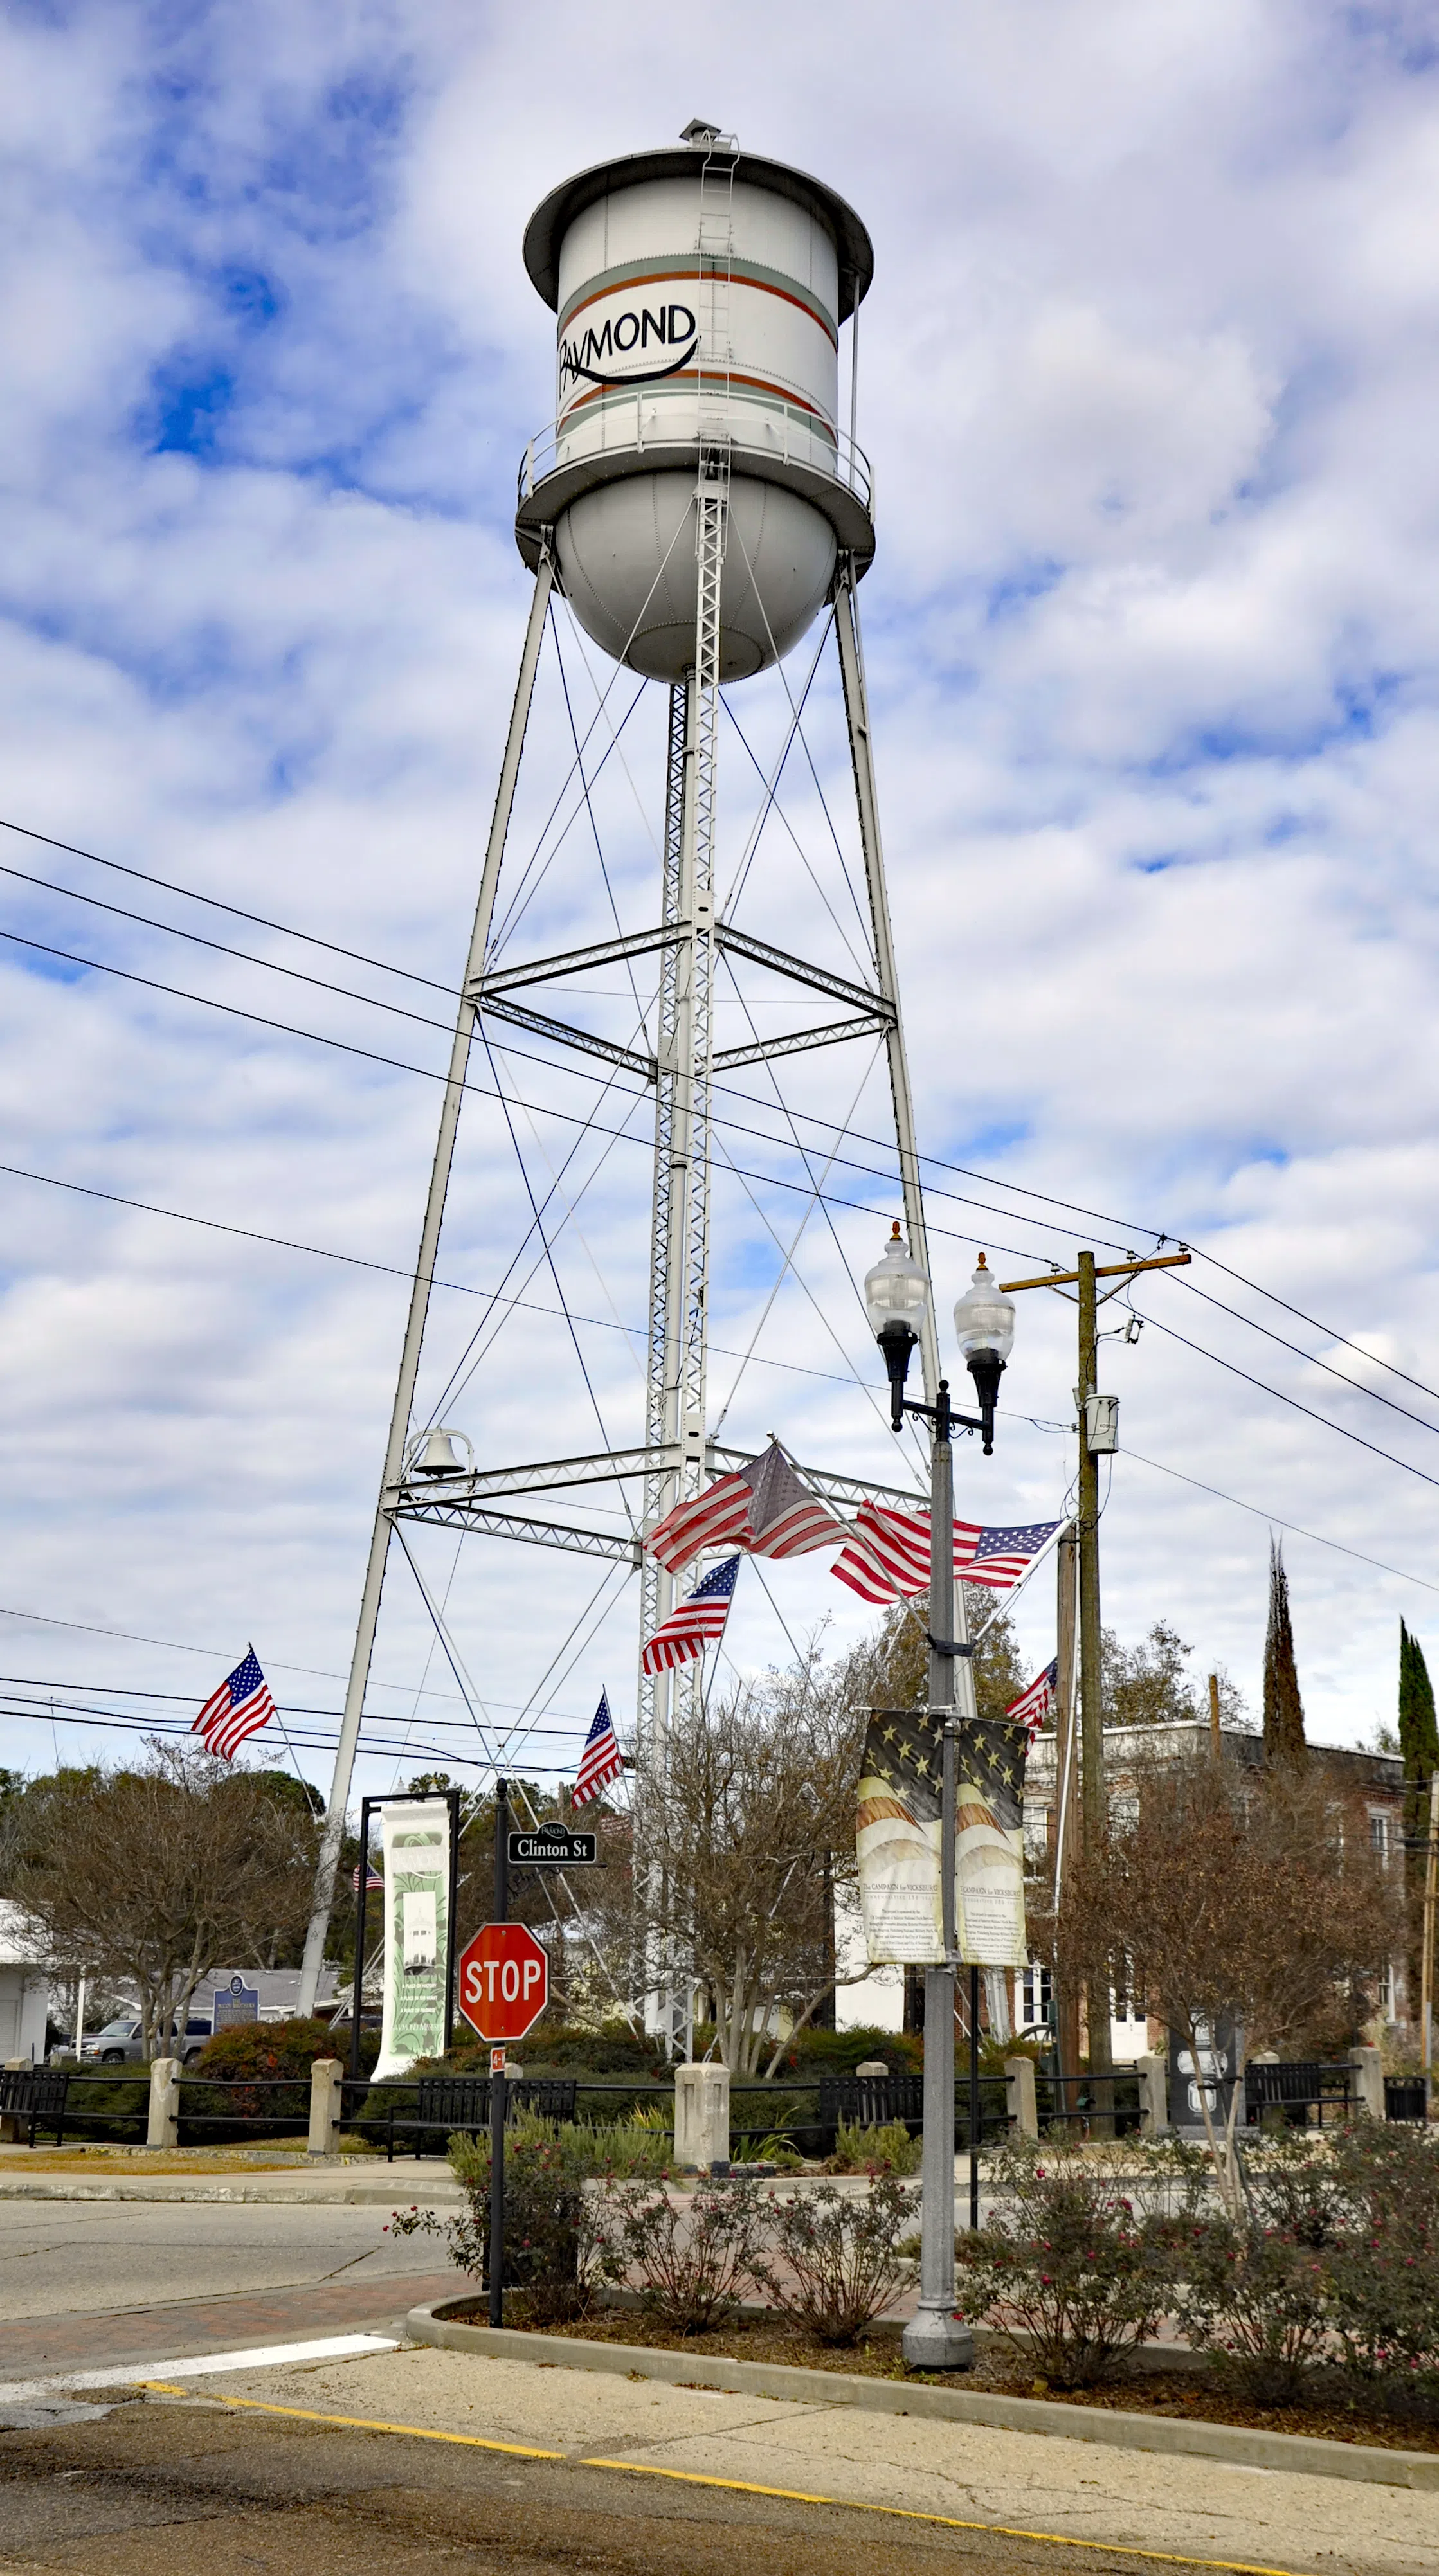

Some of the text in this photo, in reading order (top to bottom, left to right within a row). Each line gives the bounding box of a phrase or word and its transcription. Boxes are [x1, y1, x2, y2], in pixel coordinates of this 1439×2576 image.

[559, 305, 696, 399] RAYMOND
[518, 1839, 587, 1857] Clinton St
[465, 1959, 541, 2004] STOP
